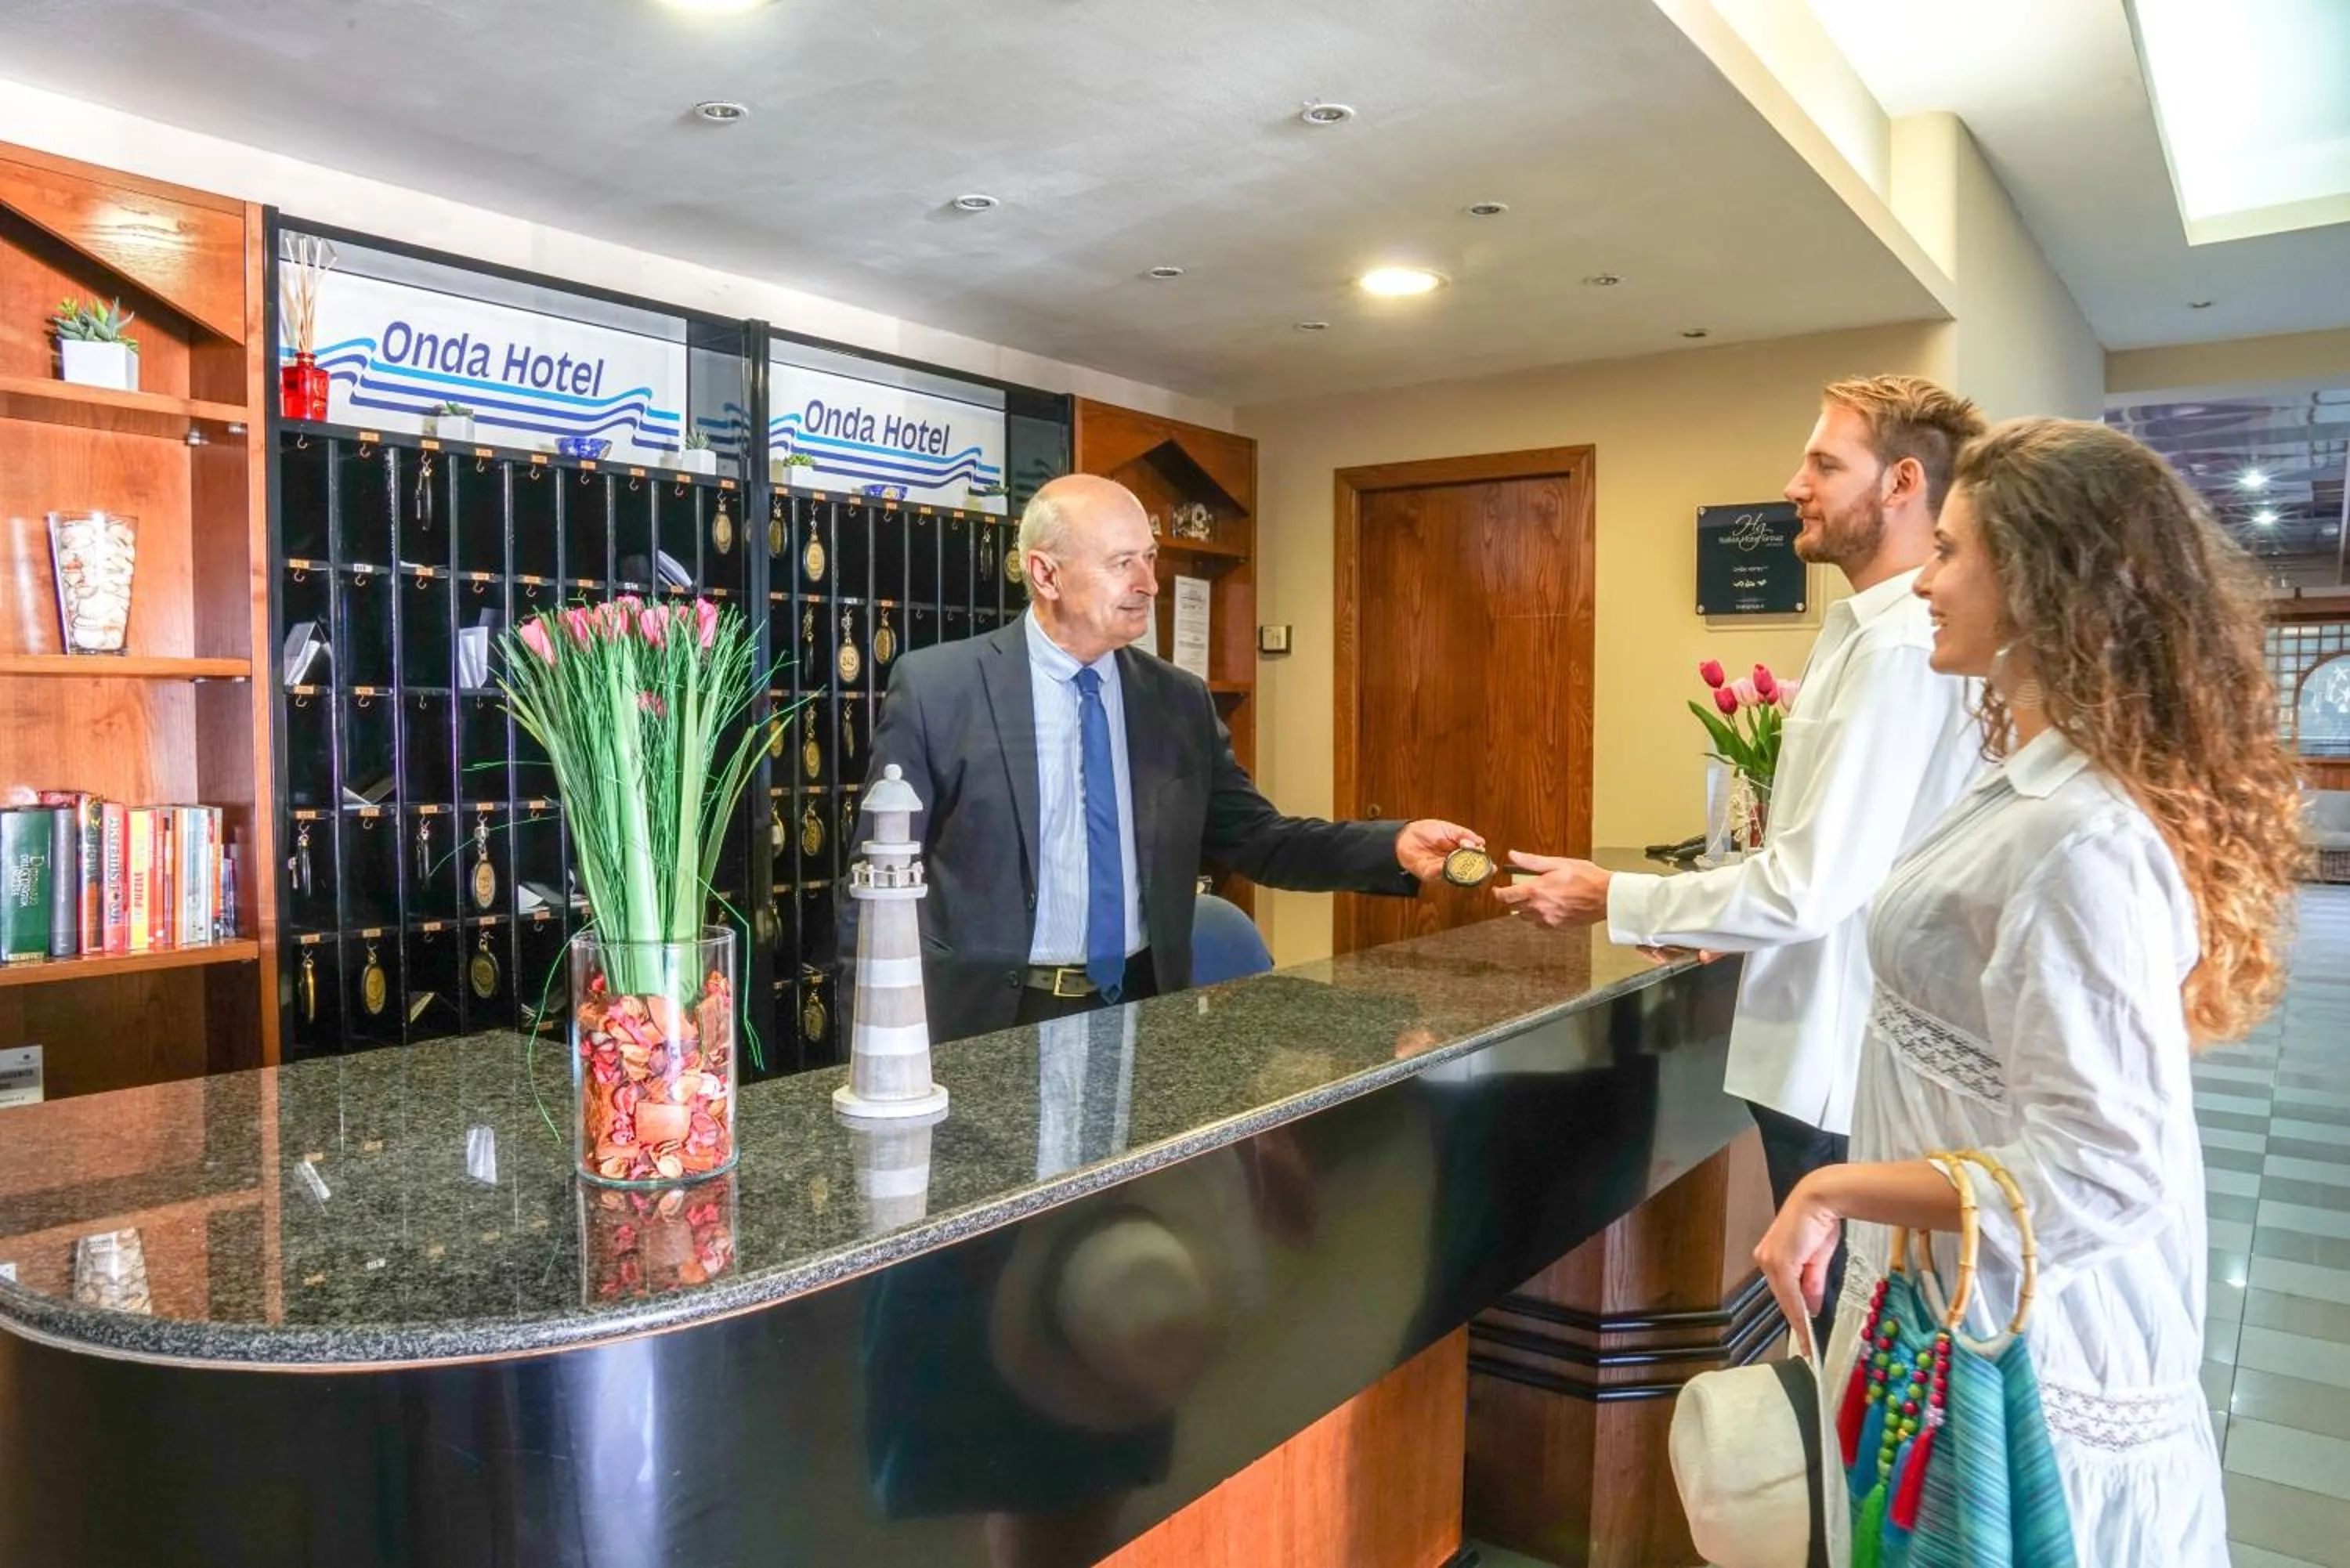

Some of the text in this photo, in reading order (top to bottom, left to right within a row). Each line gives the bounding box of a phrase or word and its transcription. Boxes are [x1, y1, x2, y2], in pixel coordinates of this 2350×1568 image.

[382, 321, 604, 397] Onda Hotel
[804, 399, 950, 456] Onda Hotel
